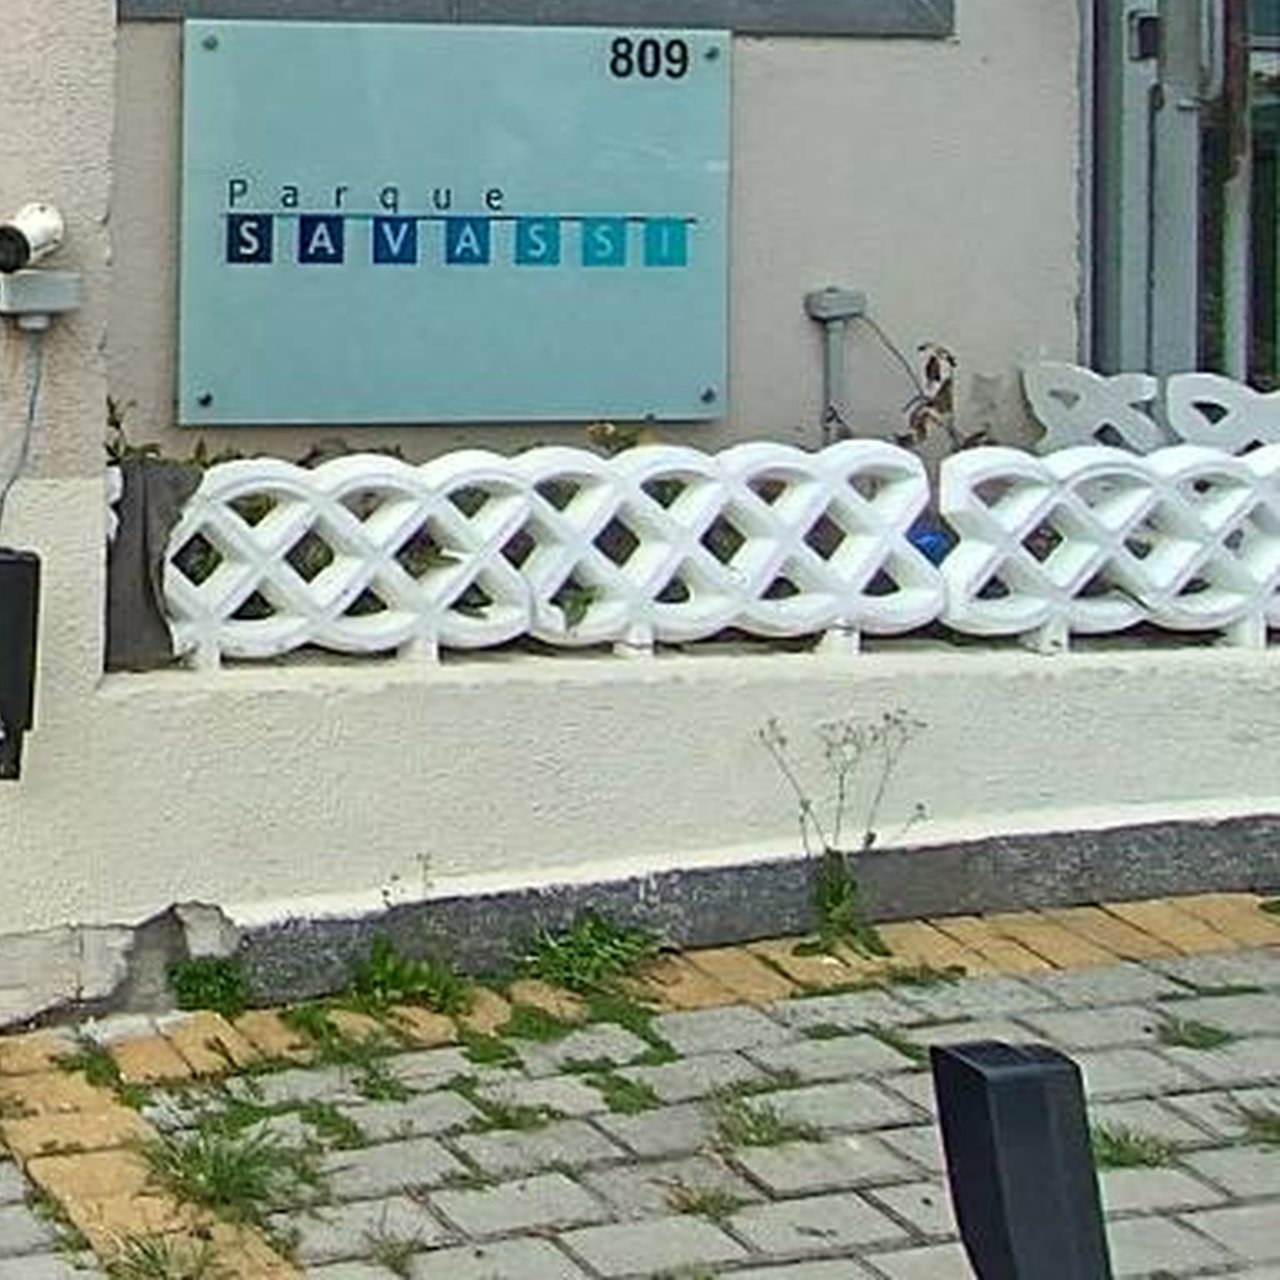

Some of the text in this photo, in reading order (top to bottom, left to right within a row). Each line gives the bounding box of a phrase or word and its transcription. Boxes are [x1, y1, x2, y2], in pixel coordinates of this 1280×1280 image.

[609, 36, 690, 79] 809
[228, 178, 504, 213] Parque
[238, 219, 672, 258] SAVASSI
